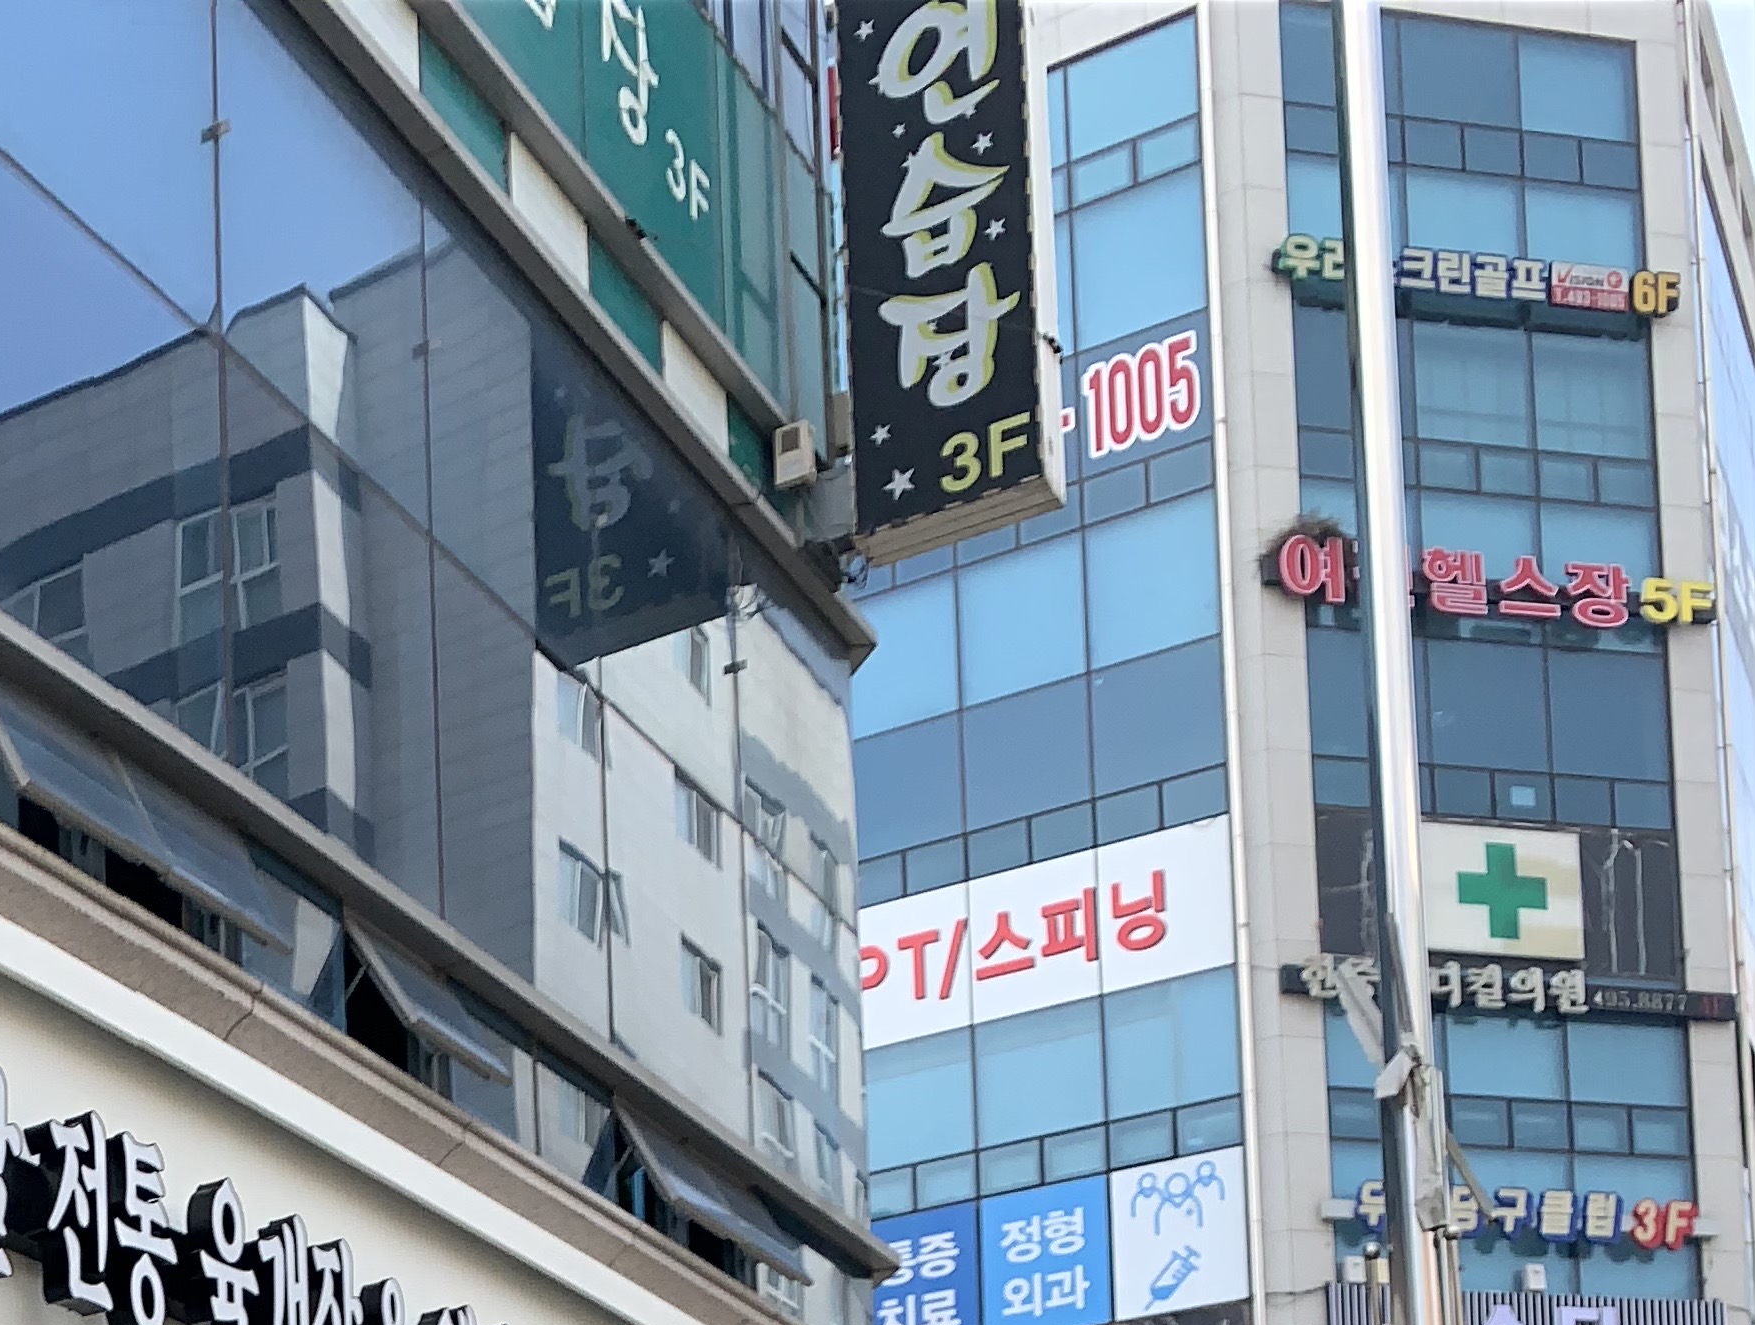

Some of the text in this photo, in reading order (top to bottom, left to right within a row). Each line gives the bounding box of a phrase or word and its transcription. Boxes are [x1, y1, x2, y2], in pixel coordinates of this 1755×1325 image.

[663, 128, 710, 220] 3F
[1632, 270, 1681, 316] 6F
[939, 410, 1031, 496] 3F
[1280, 534, 1717, 628] 여헬스장 5F
[998, 1206, 1087, 1265] 정형
[1633, 1198, 1699, 1249] 3F
[1001, 1265, 1091, 1318] 외과
